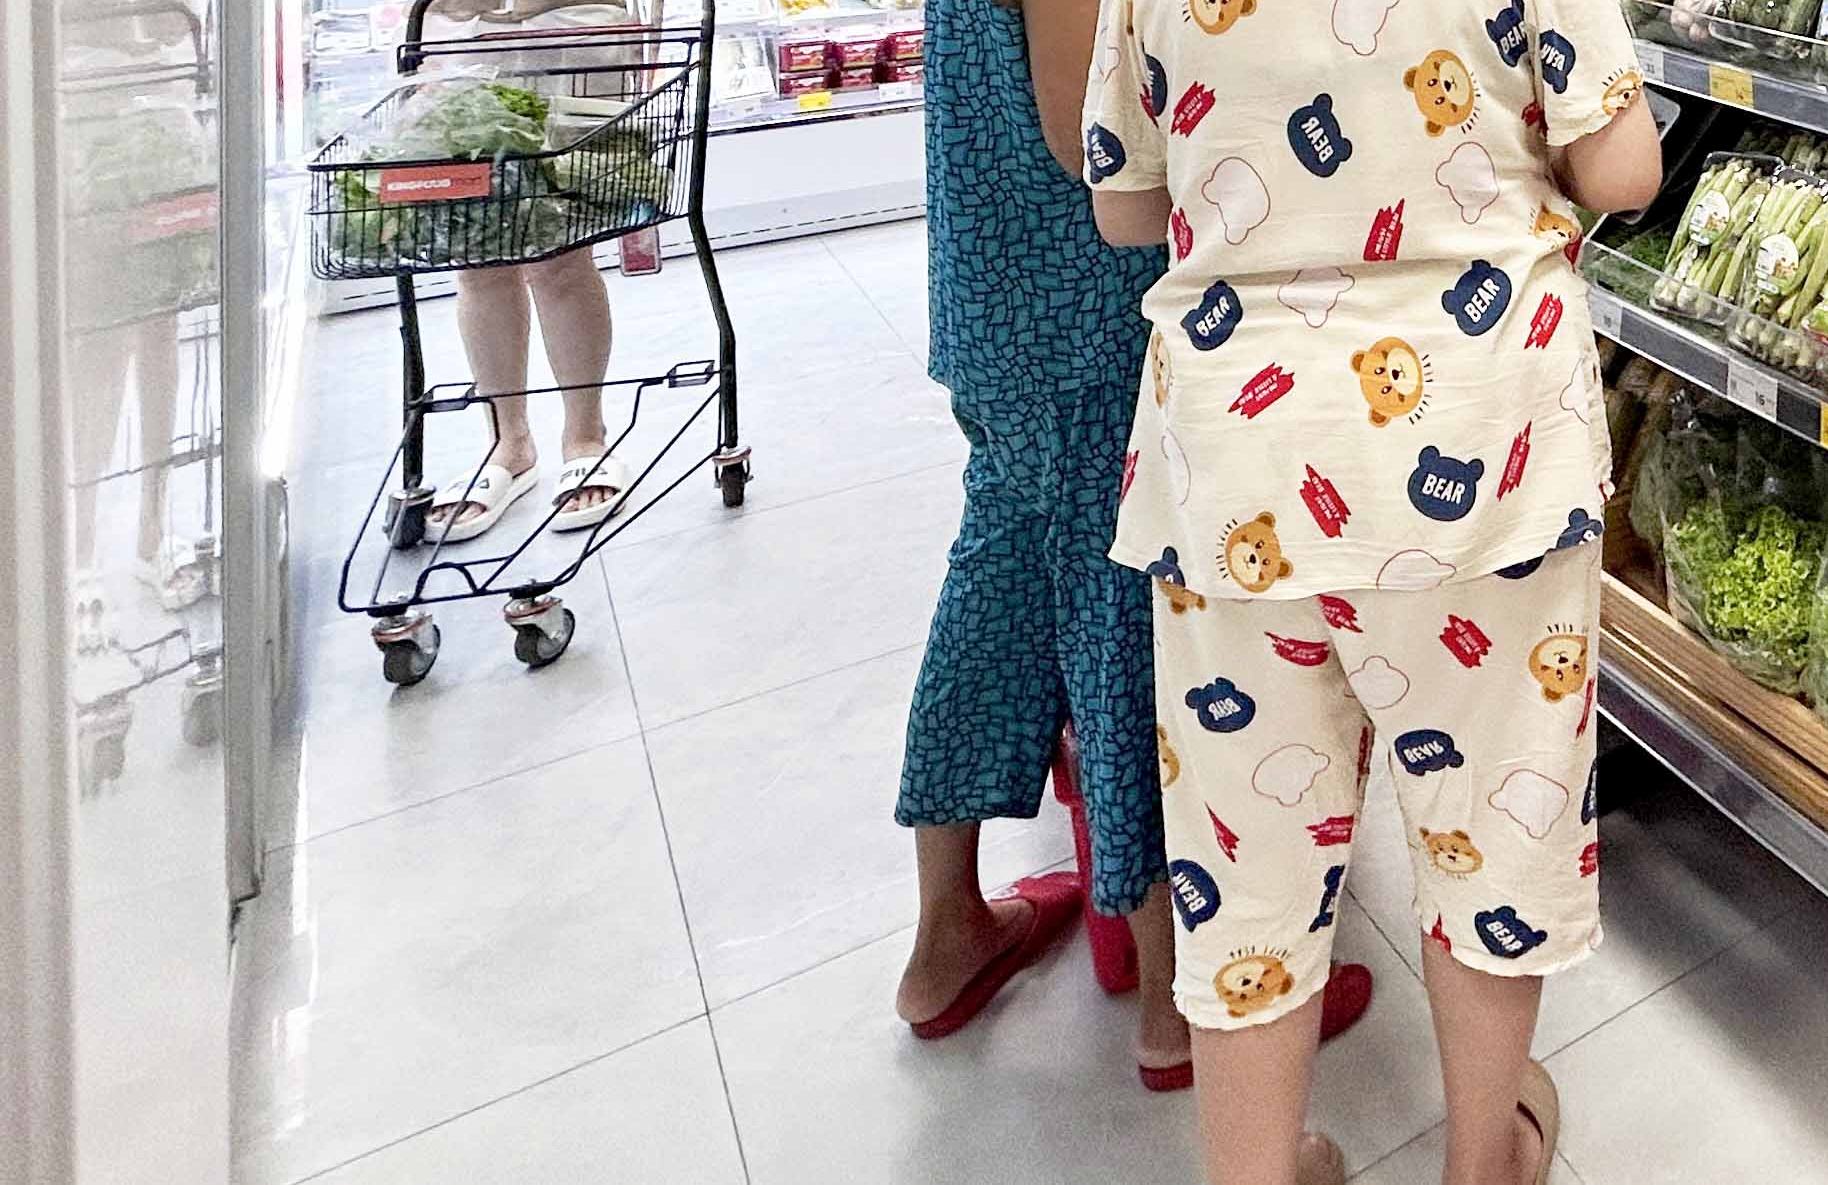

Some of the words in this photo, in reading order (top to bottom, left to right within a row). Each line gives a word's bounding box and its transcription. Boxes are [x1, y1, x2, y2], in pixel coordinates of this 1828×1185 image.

[1196, 296, 1230, 337] BEAR
[1464, 278, 1500, 323] BEAR
[1422, 473, 1465, 504] BEAR
[1486, 920, 1523, 952] BEAR
